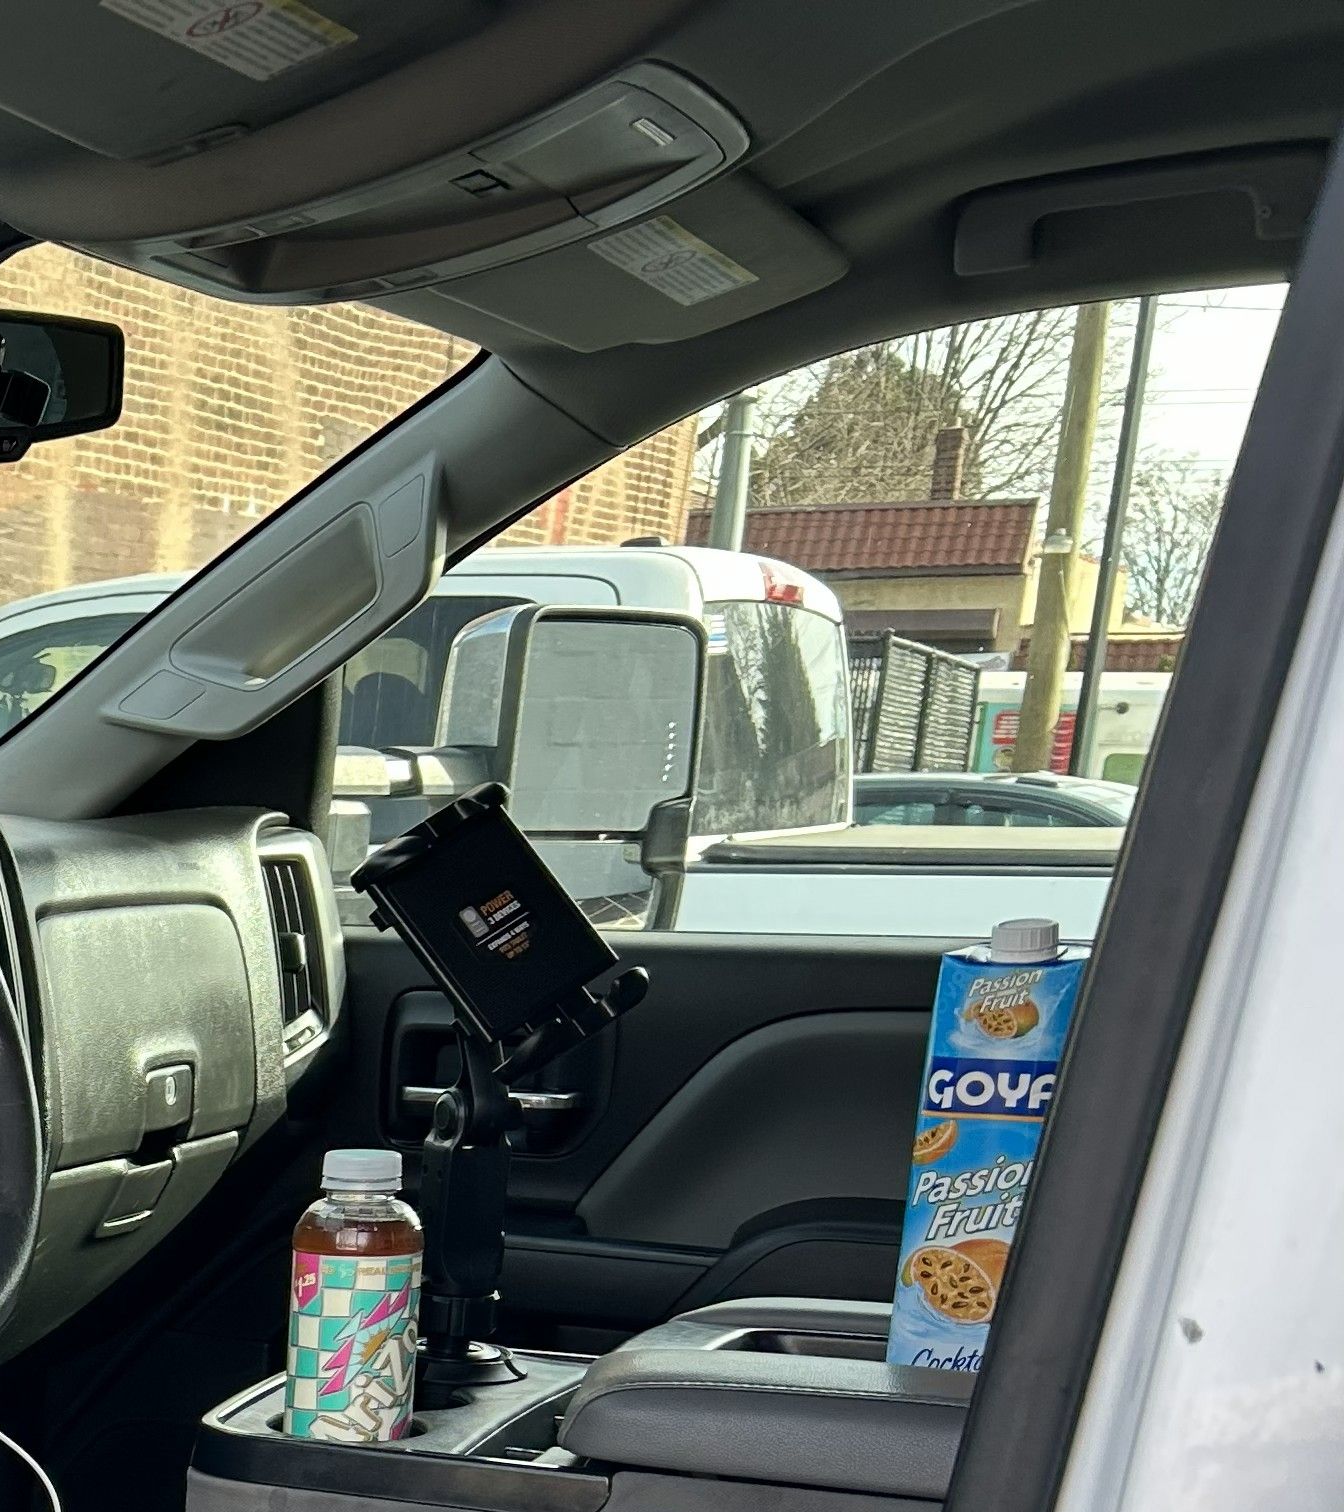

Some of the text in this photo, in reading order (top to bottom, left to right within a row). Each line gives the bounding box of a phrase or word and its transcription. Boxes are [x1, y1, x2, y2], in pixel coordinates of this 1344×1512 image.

[968, 969, 1043, 997] Passion
[980, 990, 1029, 1013] Fruit
[925, 1192, 1023, 1240] Fruit
